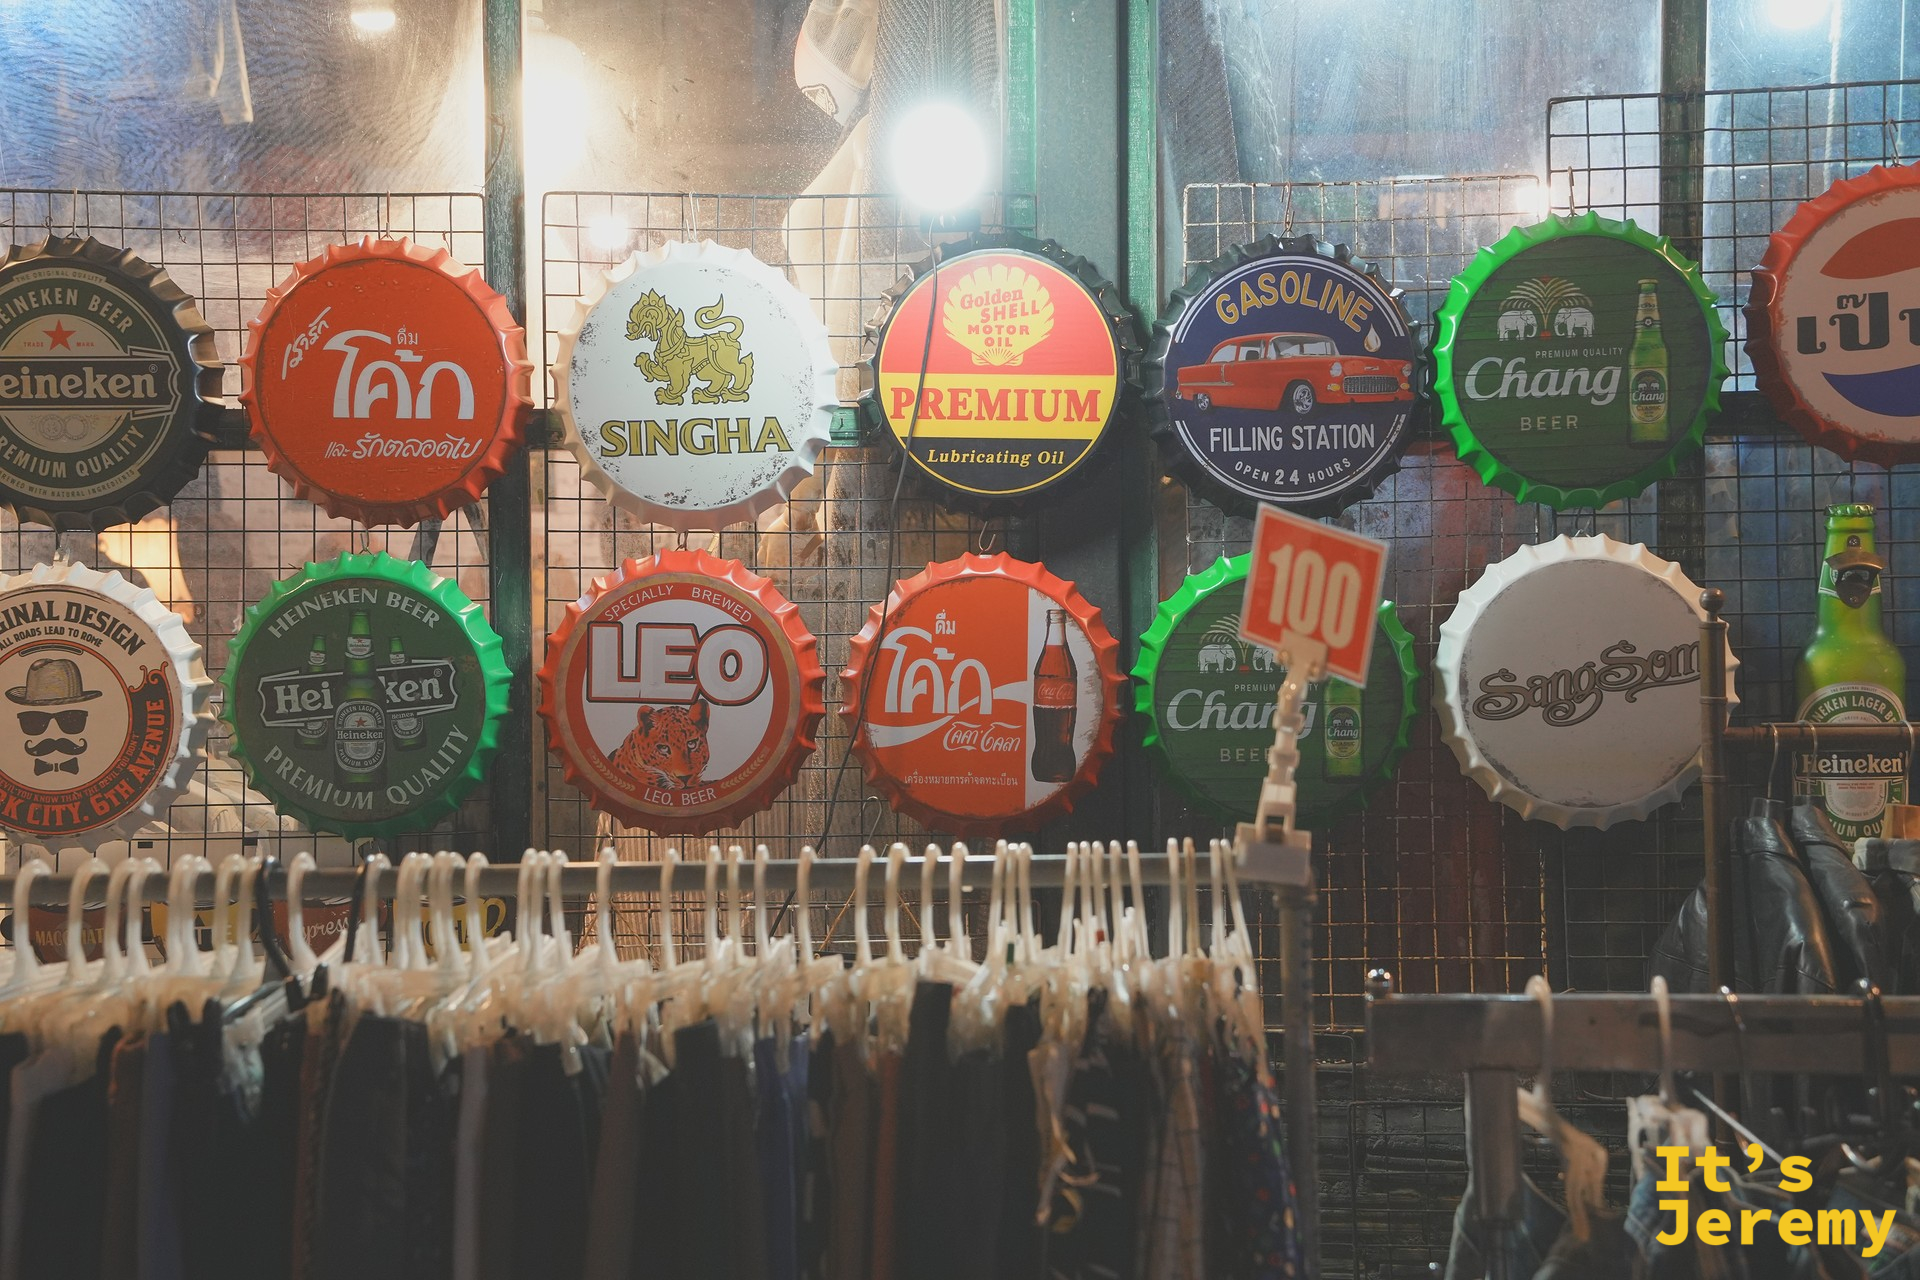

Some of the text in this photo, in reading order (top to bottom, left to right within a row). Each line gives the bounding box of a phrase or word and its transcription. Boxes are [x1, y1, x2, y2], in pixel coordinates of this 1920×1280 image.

[0, 288, 134, 334] EINEKEN BEER
[960, 288, 1024, 310] Golden
[980, 300, 1040, 324] SHELL
[1216, 270, 1374, 332] GASOLINE
[967, 324, 1030, 336] MOTOR
[984, 336, 1013, 348] OIL
[1535, 346, 1624, 360] PREMIUM QUALITY
[323, 329, 475, 421] โค้ก
[1465, 356, 1622, 406] Chang
[890, 387, 1102, 423] PREMIUM
[1631, 388, 1665, 404] Chang
[599, 416, 794, 458] SINGHA
[1520, 415, 1579, 431] BEER
[0, 425, 145, 478] REMIUM QUALITY
[1210, 423, 1375, 453] FILLING STATION
[927, 449, 1065, 468] Lubricating Oil
[1234, 457, 1351, 486] OPEN 24 HOURS
[604, 584, 753, 623] SPECIALLY BREWED
[1268, 543, 1362, 650] 100
[267, 587, 441, 639] HEINEKEN BEER
[13, 627, 42, 643] ROADS
[44, 626, 65, 635] LEAD
[68, 627, 79, 638] TO
[80, 632, 104, 648] ROME
[63, 600, 146, 657] DESIGN
[586, 621, 770, 707] LEO
[881, 626, 993, 715] โค้ก
[1234, 683, 1276, 693] PREMIUM
[1852, 695, 1887, 714] LAGER
[336, 729, 384, 740] Heineken
[1327, 726, 1359, 739] Chang
[90, 779, 135, 817] 6TH
[132, 697, 166, 784] AVENUE
[264, 723, 470, 810] PREMIUM QUALITY
[1220, 747, 1270, 762] BEE
[1801, 753, 1903, 774] Heineken
[681, 787, 717, 806] BEER
